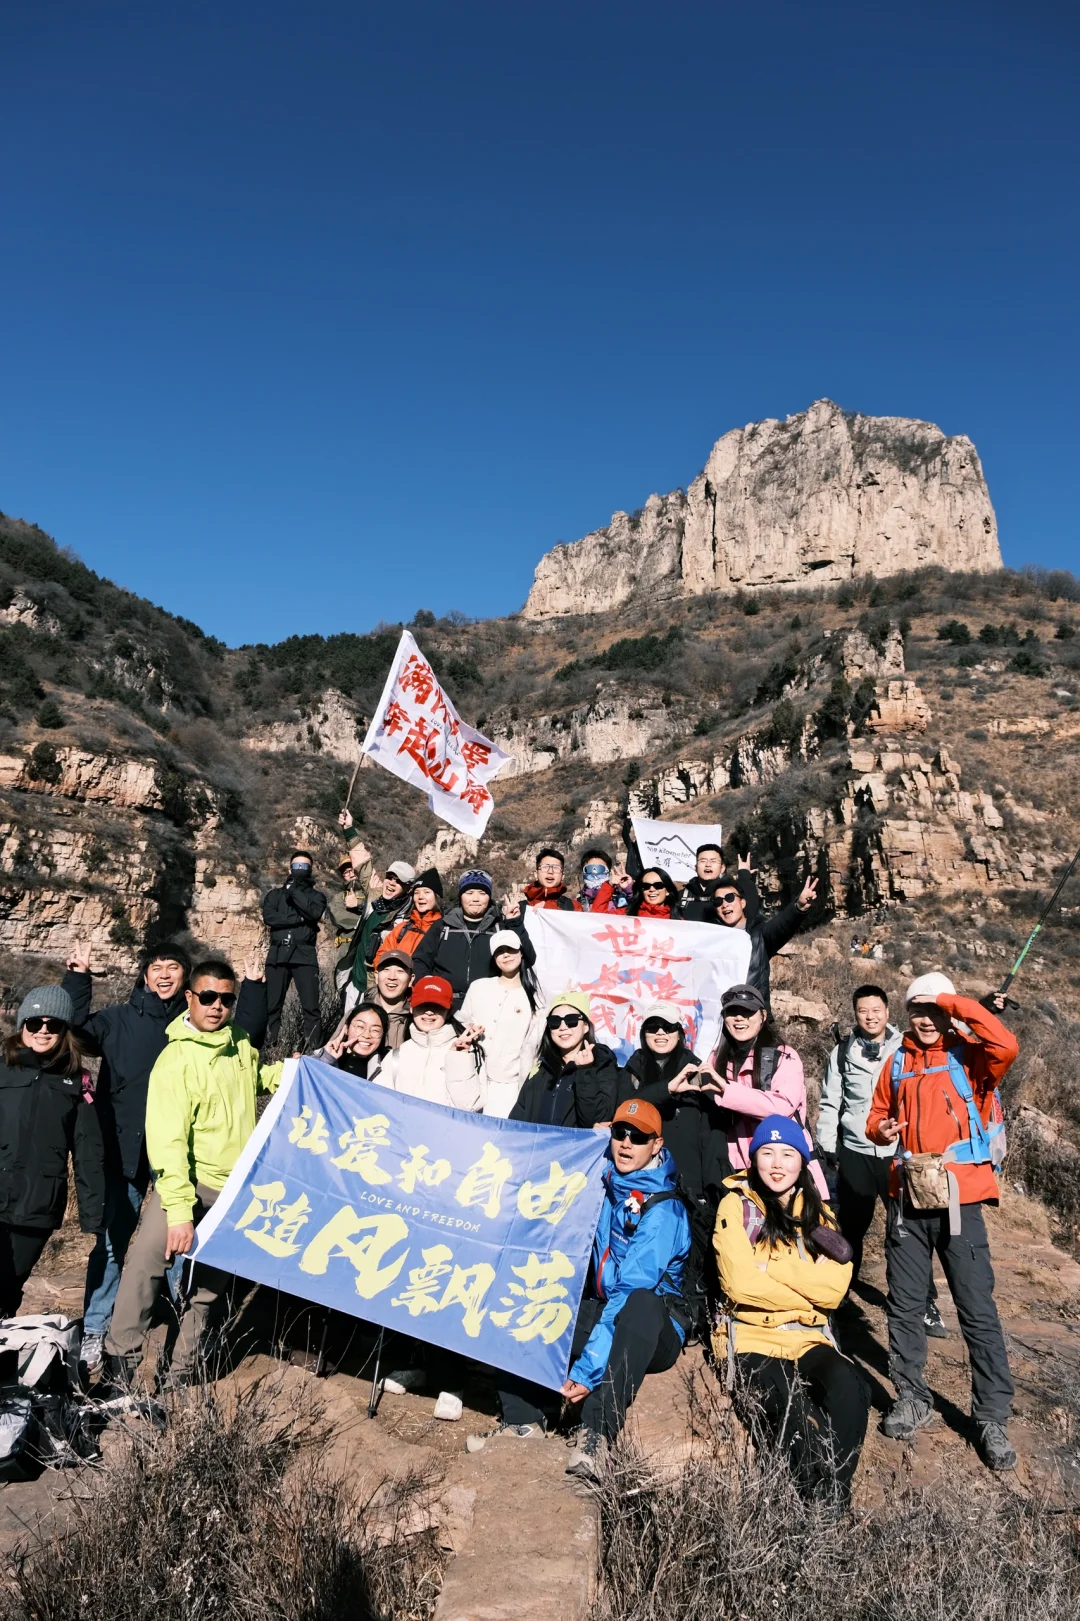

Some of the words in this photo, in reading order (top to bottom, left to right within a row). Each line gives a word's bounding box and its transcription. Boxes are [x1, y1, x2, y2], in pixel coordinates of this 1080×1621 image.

[383, 701, 492, 815] 奔赴山海
[591, 917, 693, 970] 世界
[627, 1102, 639, 1115] B
[770, 1130, 782, 1141] R
[288, 1105, 589, 1225] 让爱和自由
[360, 1191, 394, 1209] LOVE
[395, 1202, 421, 1216] AND
[422, 1210, 482, 1233] FREEDOM
[234, 1180, 577, 1345] 随风飘荡
